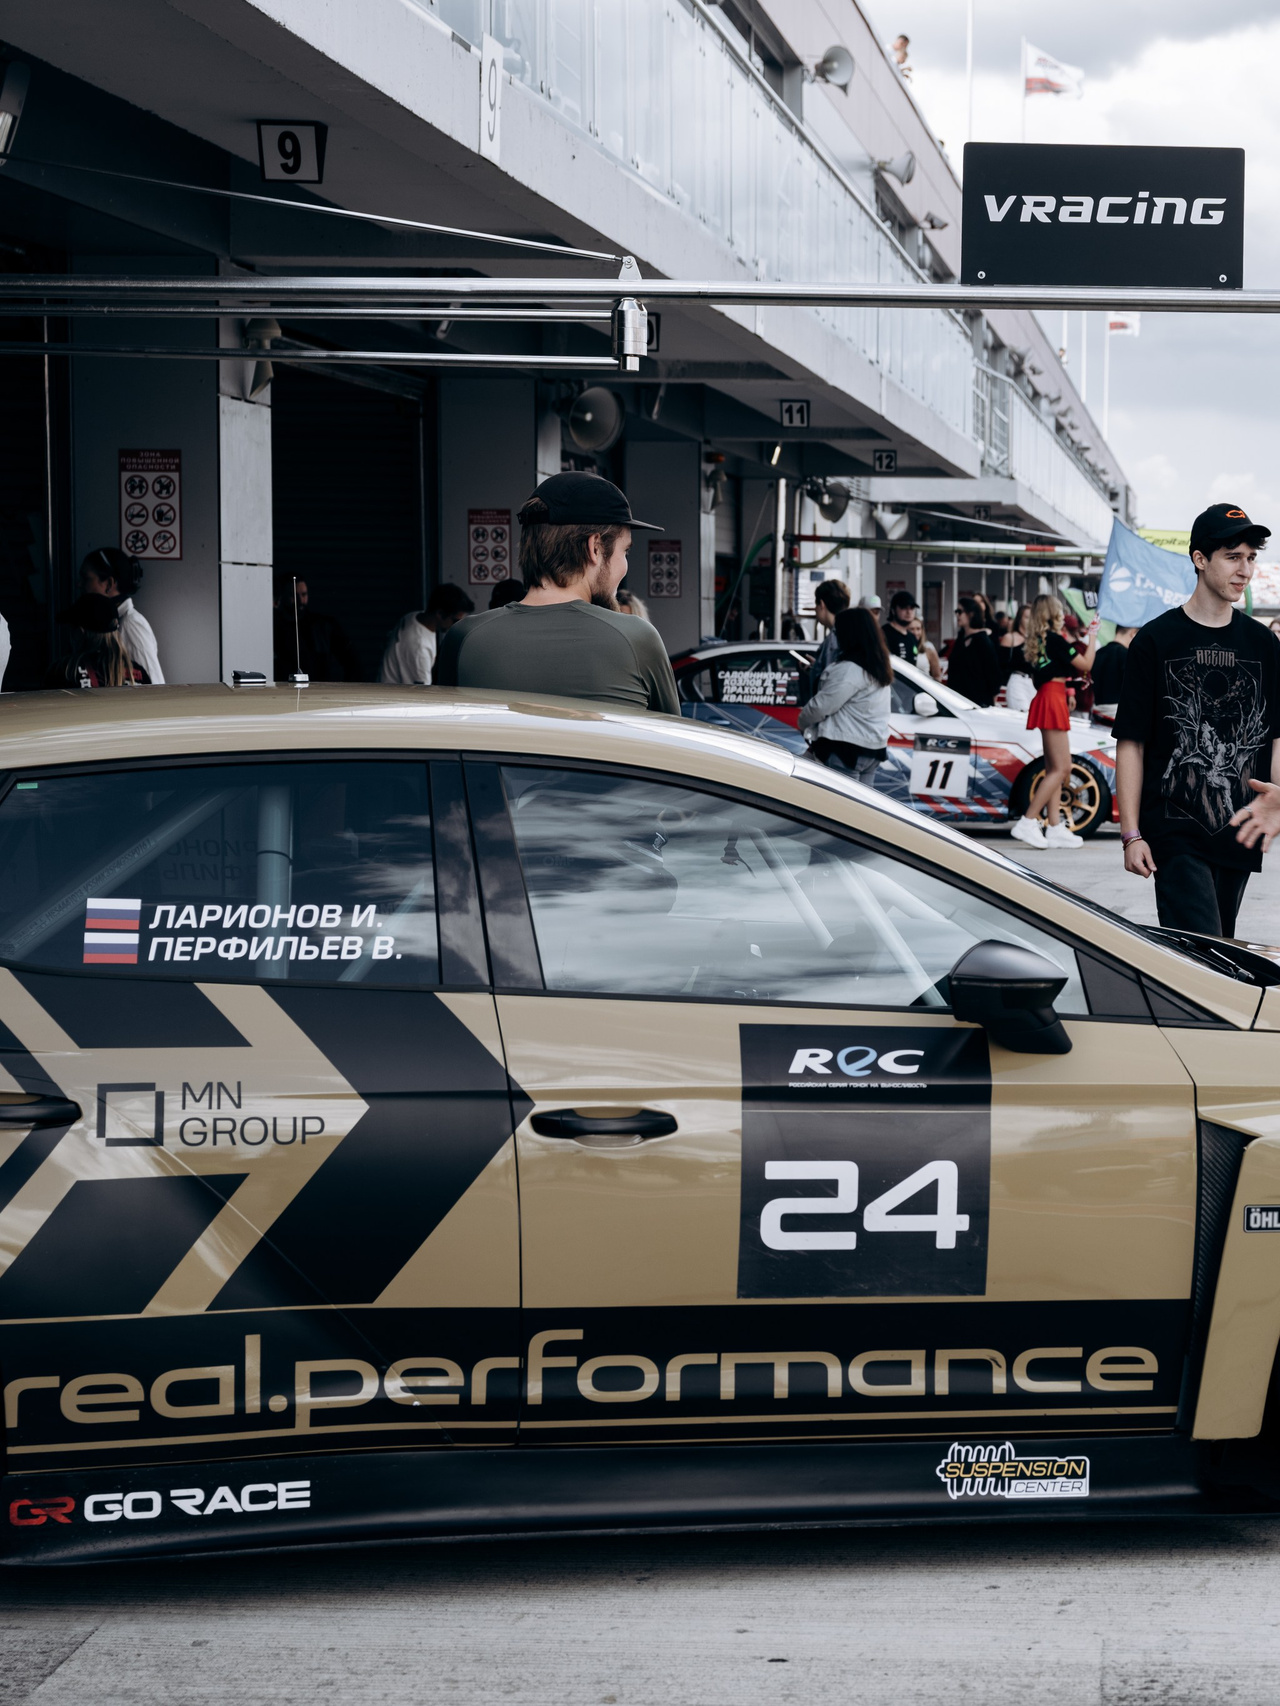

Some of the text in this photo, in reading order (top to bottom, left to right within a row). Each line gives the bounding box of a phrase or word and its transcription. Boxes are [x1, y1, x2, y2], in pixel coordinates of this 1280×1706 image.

[488, 58, 498, 142] 9
[277, 130, 302, 175] 9
[784, 403, 805, 426] 11
[876, 454, 894, 471] 12
[1196, 649, 1235, 668] ACEDIA
[722, 686, 764, 695] ПРАХОВ
[925, 759, 954, 790] 11
[149, 904, 343, 929] ЛАРИОНОВ
[350, 904, 383, 928] И.
[148, 936, 403, 961] ПЕРФИЛЬЕВ В.
[181, 1080, 242, 1111] MN
[179, 1116, 326, 1147] GROUP
[760, 1160, 970, 1251] 24
[4, 1328, 1159, 1432] real.performance
[945, 1461, 1086, 1479] SUSPENSION
[1013, 1480, 1084, 1493] CENTER
[9, 1480, 311, 1527] GR GO RACE
